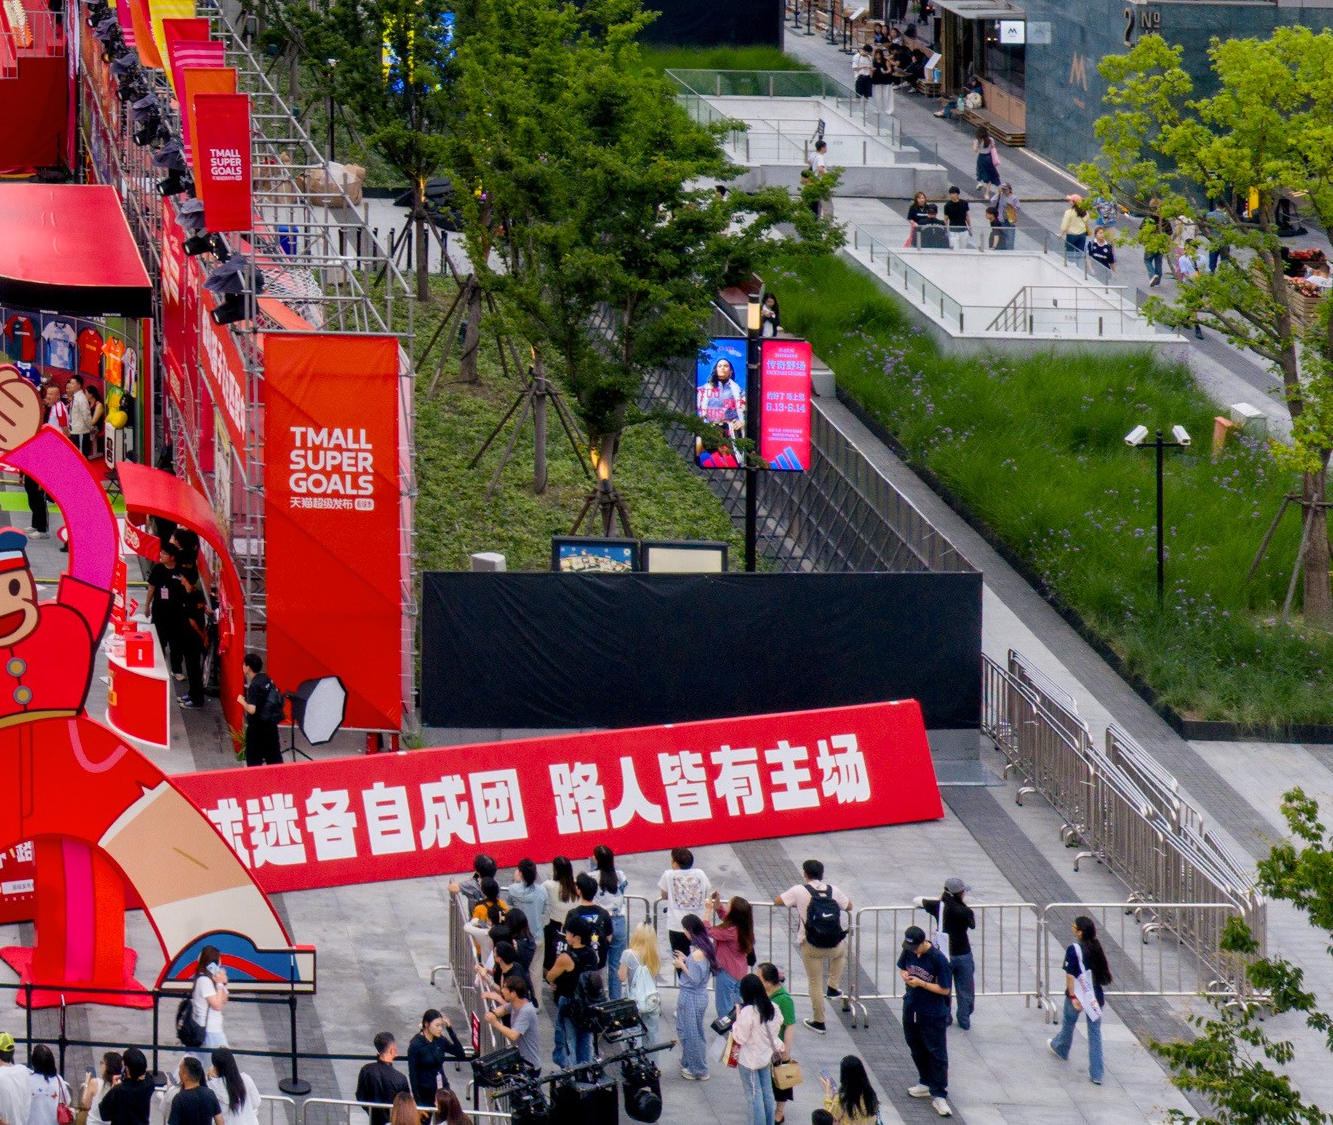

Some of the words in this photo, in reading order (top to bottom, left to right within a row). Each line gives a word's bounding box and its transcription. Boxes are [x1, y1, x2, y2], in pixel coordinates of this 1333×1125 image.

[210, 149, 241, 158] TMALL
[211, 158, 242, 167] SUPER
[211, 167, 242, 176] GOALS
[289, 426, 373, 450] TMALL
[289, 449, 374, 473] SUPER
[288, 472, 374, 496] GOALS
[289, 496, 354, 510] 天猫超级发布
[550, 733, 871, 836] 路人皆有主场
